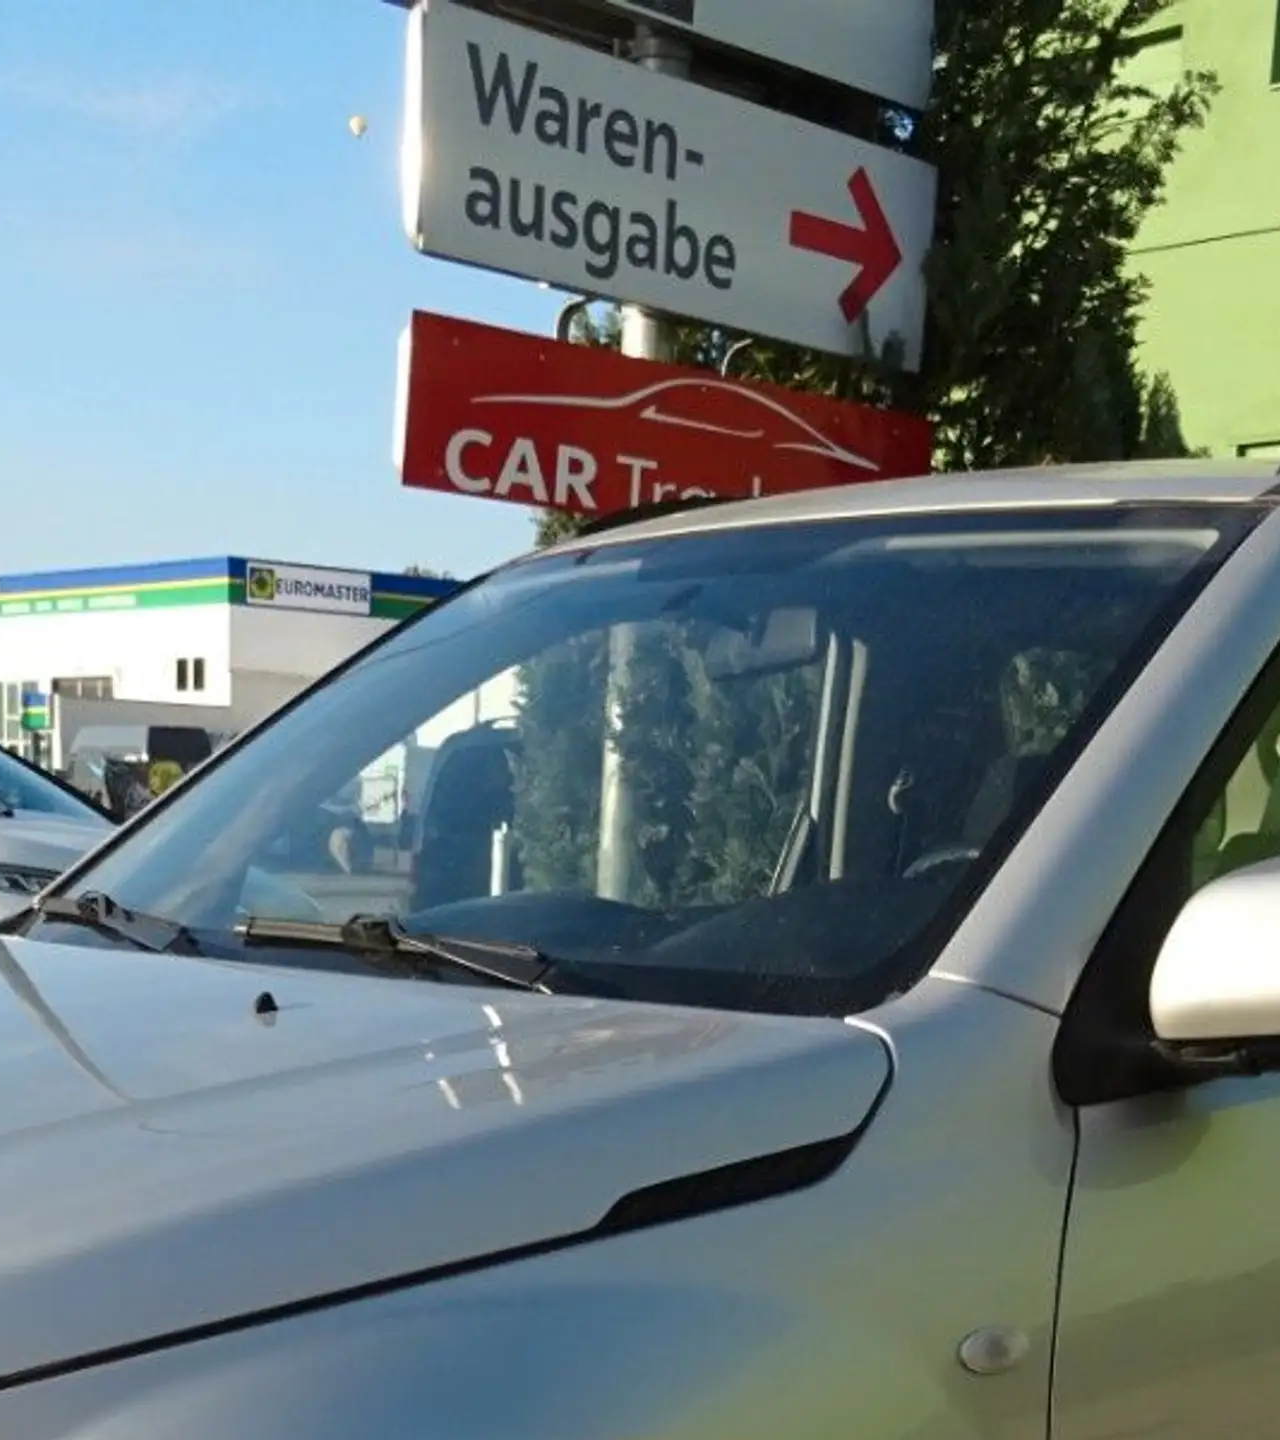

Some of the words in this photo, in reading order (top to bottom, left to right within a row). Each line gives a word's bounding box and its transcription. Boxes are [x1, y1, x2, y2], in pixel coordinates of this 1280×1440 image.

[466, 42, 704, 181] Waren-
[465, 166, 736, 290] ausgabe
[444, 428, 598, 510] CAR
[275, 577, 369, 603] EUROMASTER
